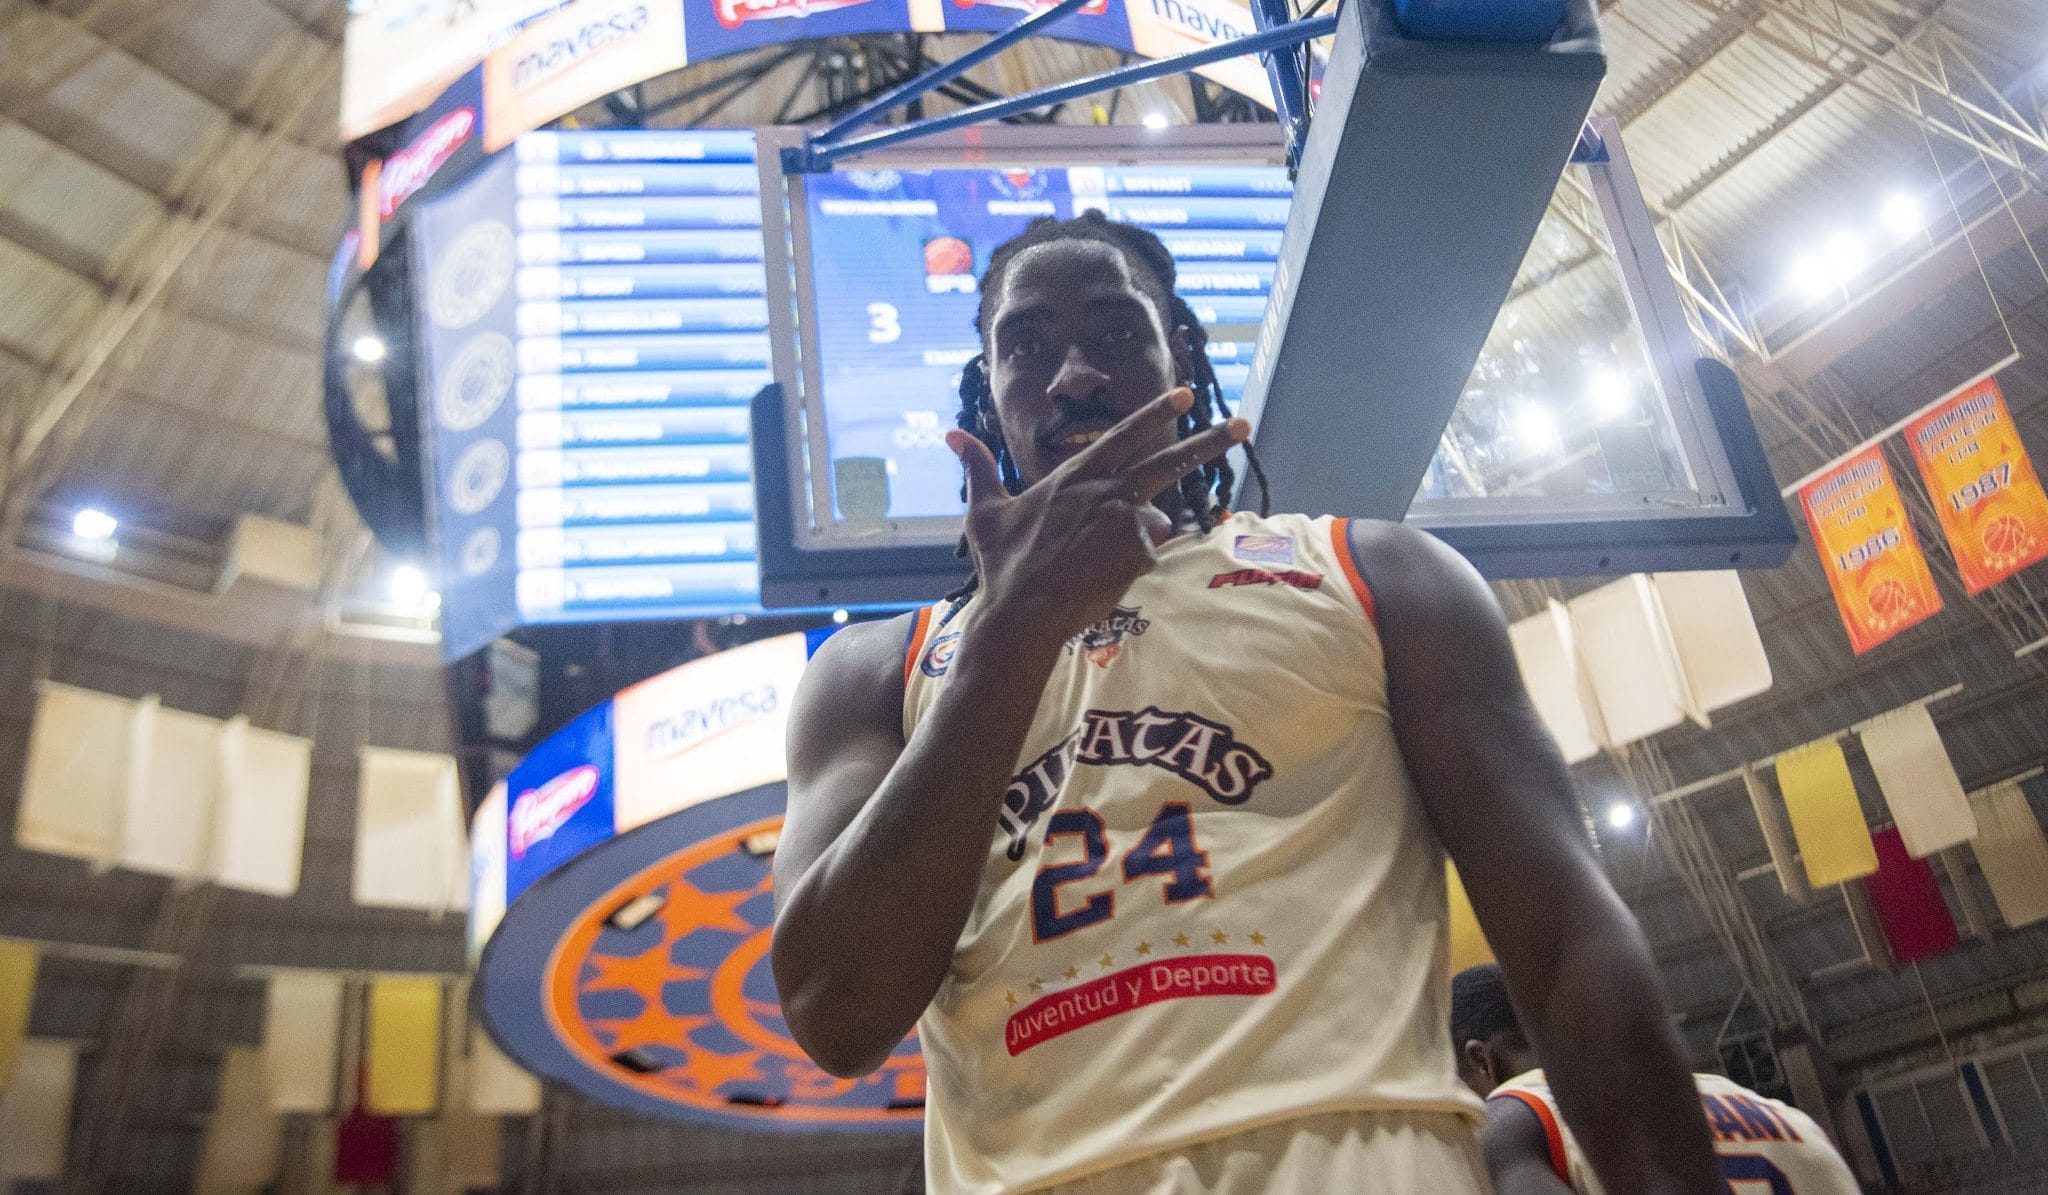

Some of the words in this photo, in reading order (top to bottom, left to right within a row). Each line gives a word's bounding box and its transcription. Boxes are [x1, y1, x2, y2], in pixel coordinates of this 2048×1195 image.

[511, 5, 651, 88] mavesa
[1149, 0, 1247, 41] mave
[866, 302, 901, 344] 3
[1949, 460, 2011, 512] 1987
[1838, 526, 1900, 573] 1986
[645, 684, 779, 751] mavesa
[1030, 800, 1216, 944] 24
[1009, 979, 1119, 1046] Juventud
[1126, 976, 1143, 1005] y
[1150, 963, 1271, 993] Deporte
[1701, 1093, 1805, 1144] ANT
